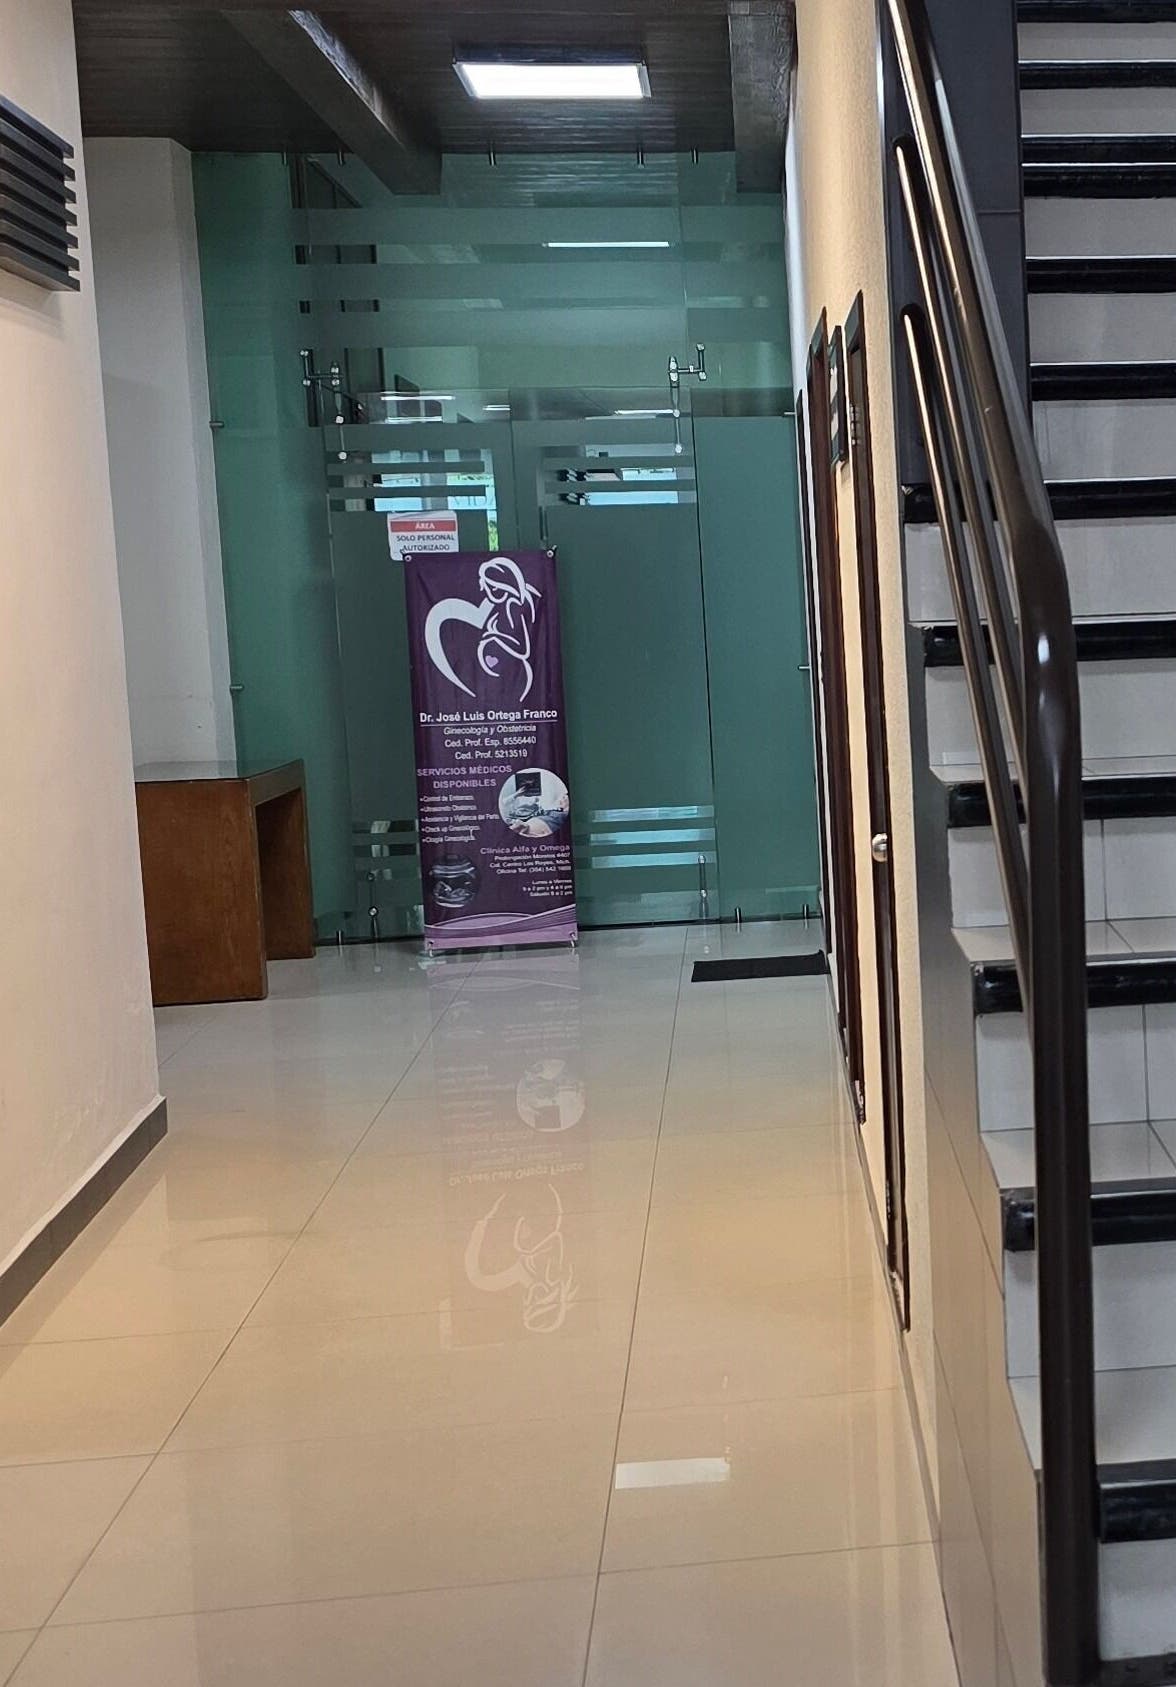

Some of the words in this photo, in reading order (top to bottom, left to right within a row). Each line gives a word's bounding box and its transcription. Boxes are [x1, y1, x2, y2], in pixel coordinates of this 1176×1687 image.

[420, 713, 433, 722] Dr.
[436, 712, 460, 722] José
[463, 711, 484, 721] Luis
[488, 710, 521, 722] Ortega
[523, 709, 557, 719] Franco
[497, 725, 536, 733] Obstetricia
[465, 739, 481, 747] Prof.
[417, 767, 467, 776] SERVICIOS
[469, 765, 512, 775] MÉDICOS
[433, 779, 496, 789] DISPONIBLES
